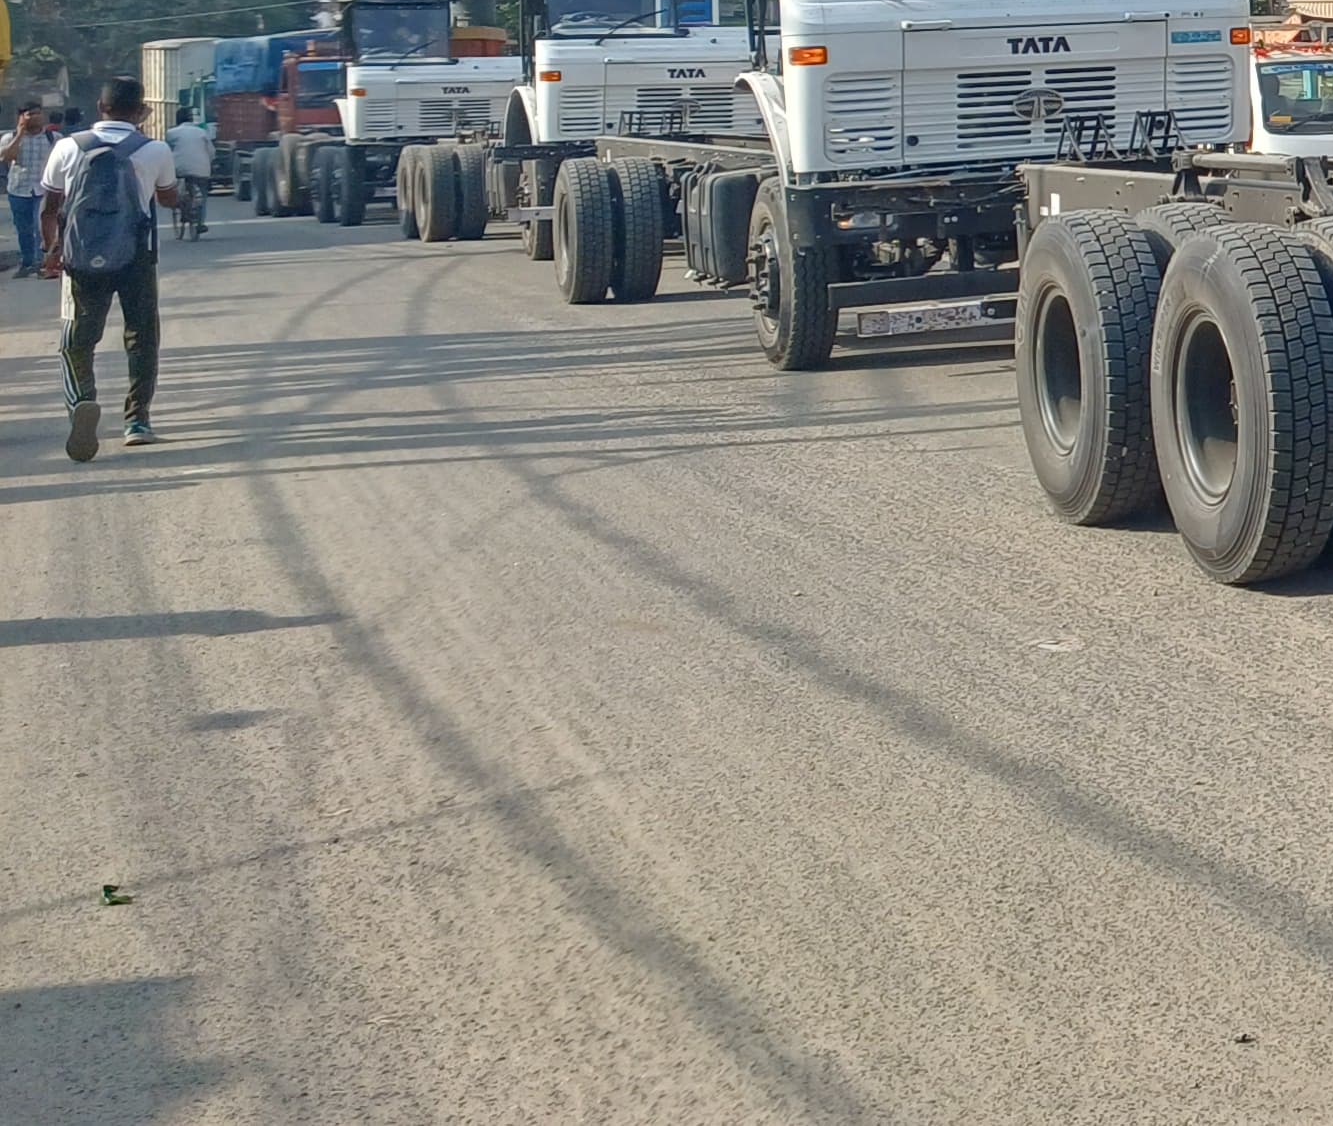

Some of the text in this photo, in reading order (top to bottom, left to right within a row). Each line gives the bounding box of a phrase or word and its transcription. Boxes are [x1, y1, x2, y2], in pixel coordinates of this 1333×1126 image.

[1007, 36, 1072, 54] TATA
[667, 68, 707, 79] TATA
[441, 86, 471, 95] TATA
